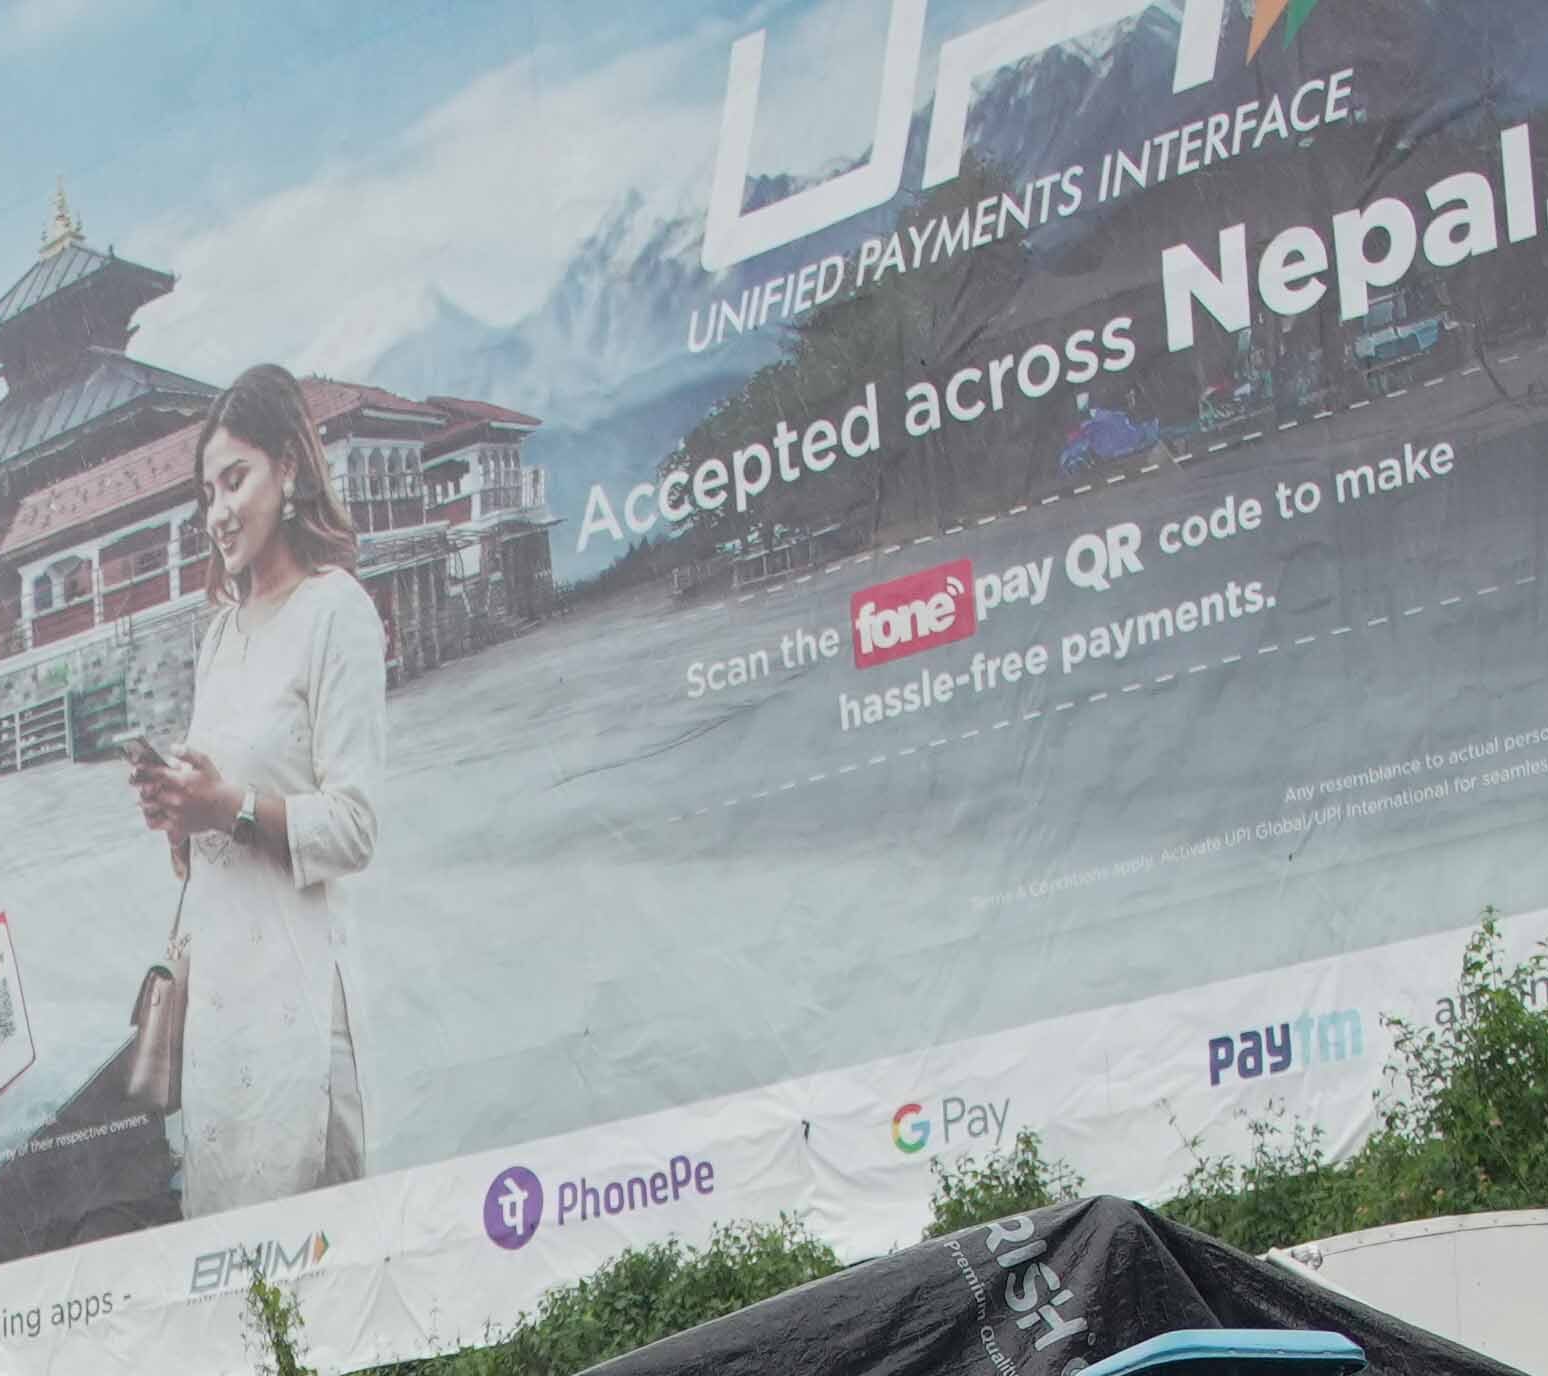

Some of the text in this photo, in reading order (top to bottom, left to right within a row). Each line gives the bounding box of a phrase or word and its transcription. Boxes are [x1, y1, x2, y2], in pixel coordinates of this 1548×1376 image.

[687, 67, 1354, 353] UNIFIED PAYMENTS INTERFACE
[574, 385, 881, 553] Accepted
[905, 315, 1135, 440] across
[686, 652, 769, 700] Scan
[779, 625, 840, 673] the
[1066, 523, 1144, 592] QR
[1160, 496, 1263, 554] code
[1276, 479, 1321, 521] to
[1336, 442, 1454, 503] make
[840, 577, 1277, 731] hassle-free payments.
[1283, 782, 1315, 805] Any
[1319, 757, 1422, 794] resemblance
[1425, 752, 1444, 770] to
[1449, 735, 1499, 763] actual
[1225, 828, 1251, 848] UPI
[1346, 780, 1450, 820] International
[1454, 774, 1478, 794] for
[942, 1096, 1010, 1146] Pay
[557, 1154, 715, 1227] PhonePe
[49, 1290, 114, 1330] apps
[944, 1240, 988, 1321] Premium
